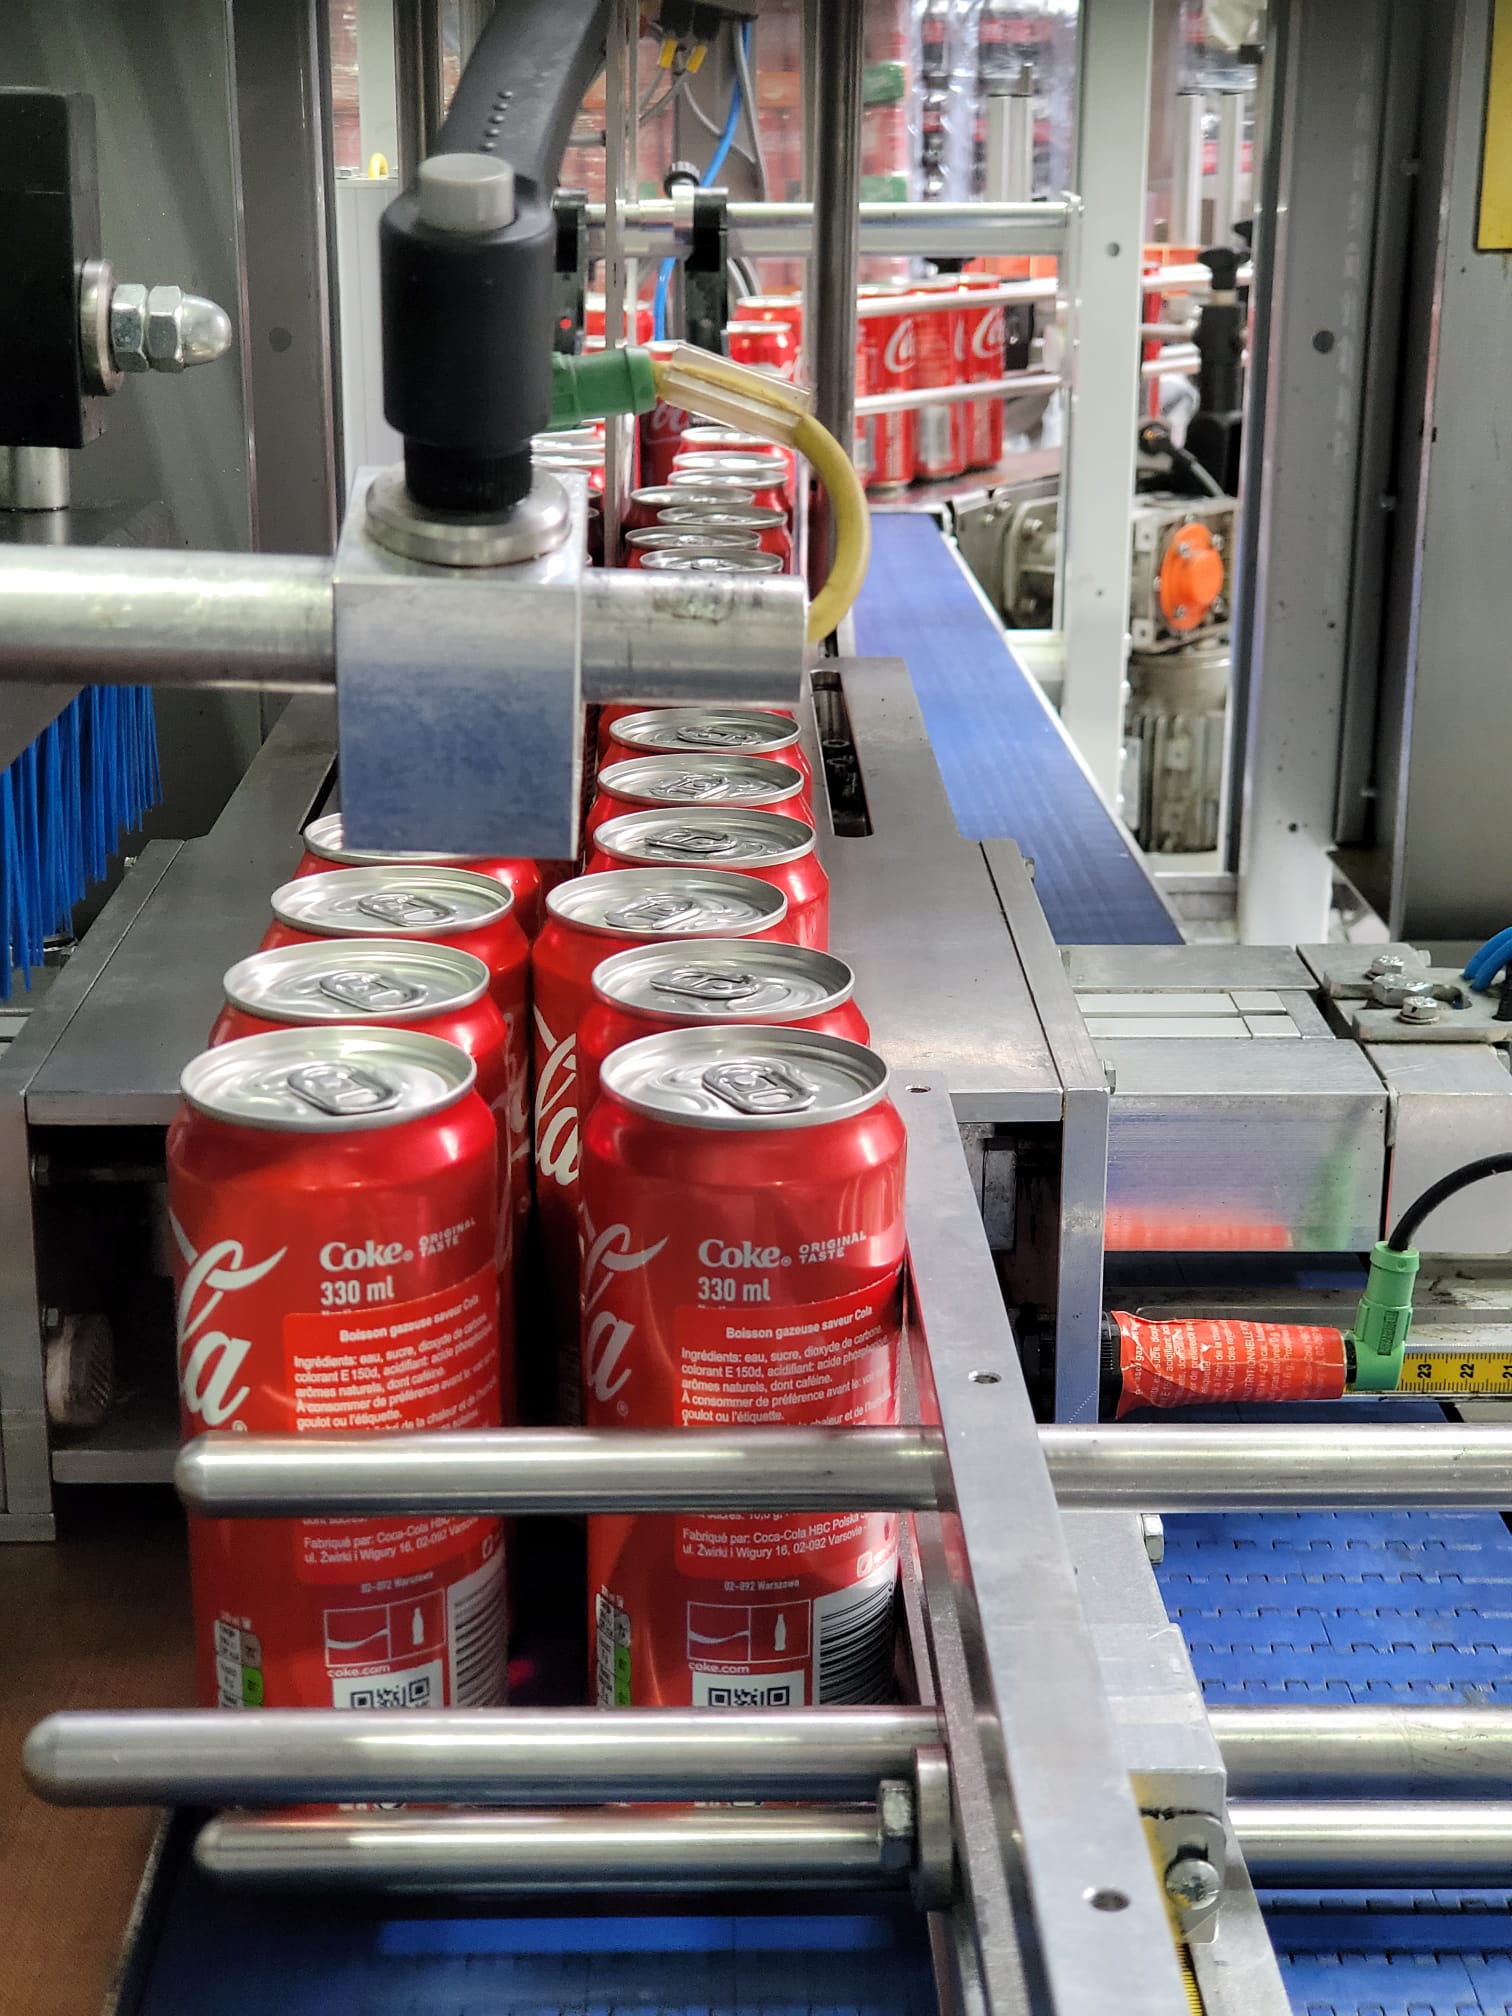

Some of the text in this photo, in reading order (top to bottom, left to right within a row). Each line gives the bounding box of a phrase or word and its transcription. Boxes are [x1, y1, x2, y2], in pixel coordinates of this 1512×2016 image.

[420, 1216, 476, 1246] ORIGINAL
[799, 1230, 867, 1254] ORIGINAL
[799, 1246, 845, 1264] TASTE
[320, 1275, 395, 1306] 330 ml
[698, 1276, 771, 1302] 330 ml
[726, 1305, 873, 1340] Boisson gazeuse saveur Cola
[339, 1327, 388, 1342] Boisson
[681, 1347, 742, 1364] Ingrédients:
[744, 1352, 768, 1364] eau,
[804, 1340, 841, 1358] dioxyde
[841, 1335, 853, 1349] de
[341, 1369, 350, 1382] E
[681, 1363, 723, 1379] colorant
[725, 1366, 734, 1378] E
[736, 1365, 764, 1379] 150d,
[1417, 1363, 1432, 1378] 23
[1460, 1363, 1474, 1378] 22
[681, 1378, 721, 1394] arômes
[770, 1377, 794, 1392] dont
[692, 1394, 753, 1407] consommer
[755, 1393, 770, 1407] de
[771, 1389, 825, 1408] préférence
[826, 1381, 850, 1398] avant
[681, 1407, 714, 1422] goulot
[715, 1410, 729, 1422] ou
[683, 1527, 728, 1545] Fabriqué
[753, 1527, 807, 1543] Coca-Cola
[808, 1520, 831, 1537] HBC
[736, 1546, 773, 1560] Wigury
[793, 1537, 827, 1554] 02-092
[326, 1663, 391, 1679] coke.com
[688, 1660, 750, 1675] coke.com
